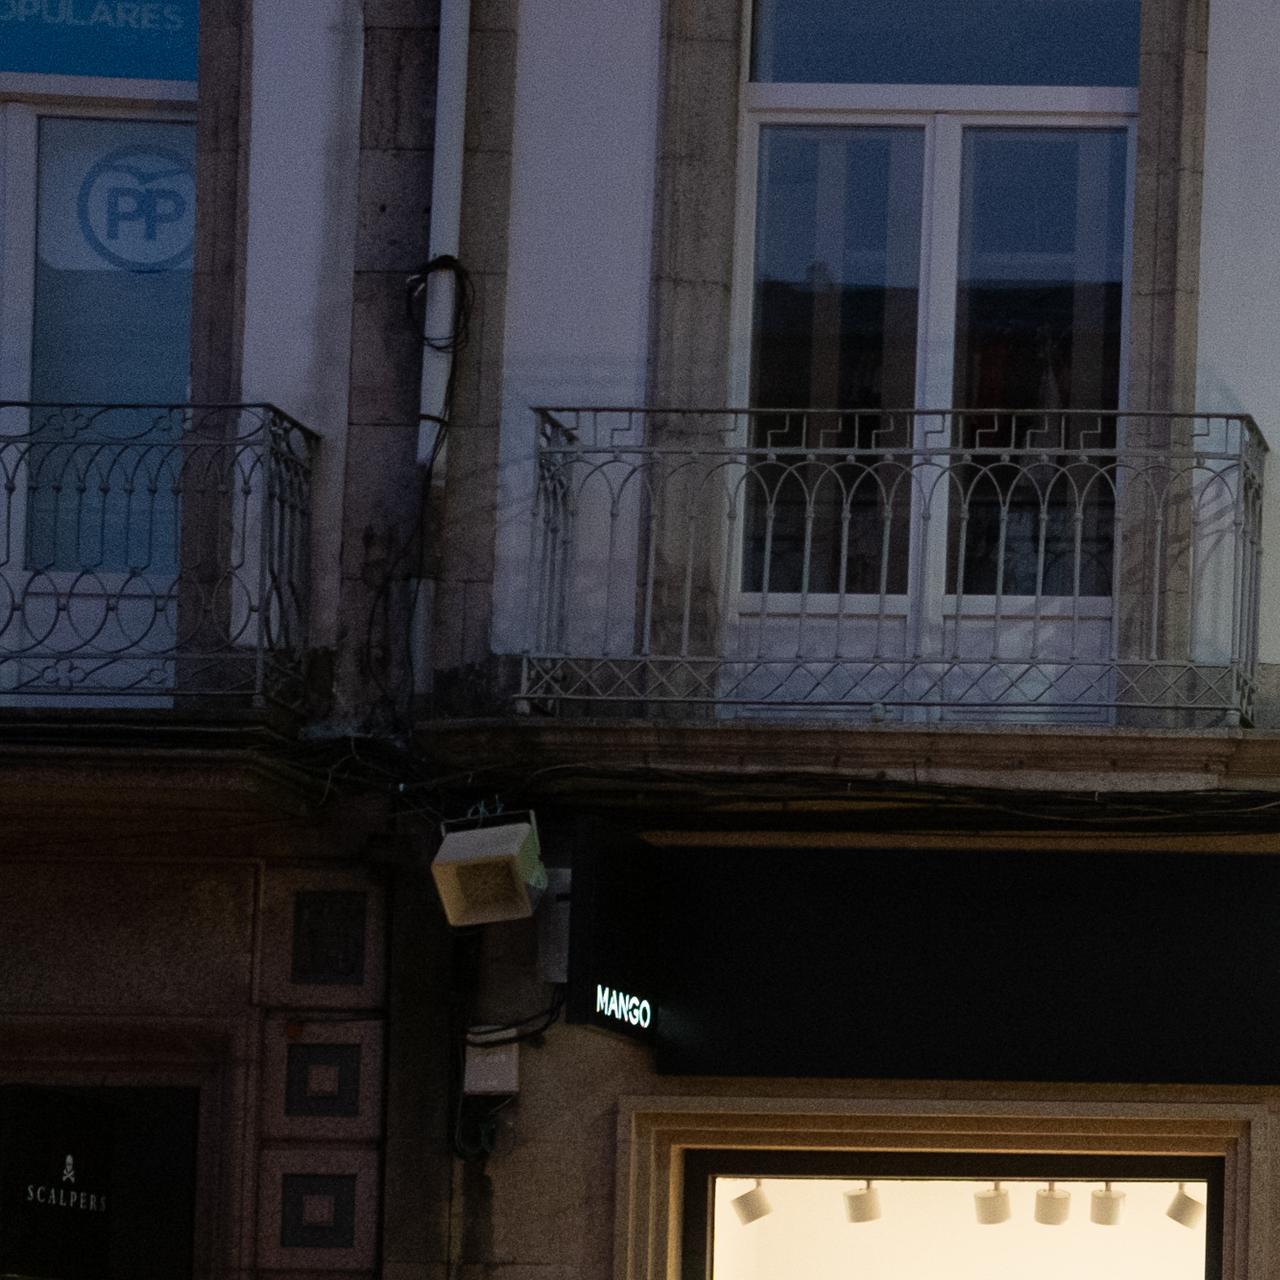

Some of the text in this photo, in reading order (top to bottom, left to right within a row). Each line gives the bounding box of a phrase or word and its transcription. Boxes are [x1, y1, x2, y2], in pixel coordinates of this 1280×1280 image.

[107, 187, 186, 241] PP
[596, 984, 651, 1028] MANGO
[26, 1183, 107, 1213] SCALPERS
